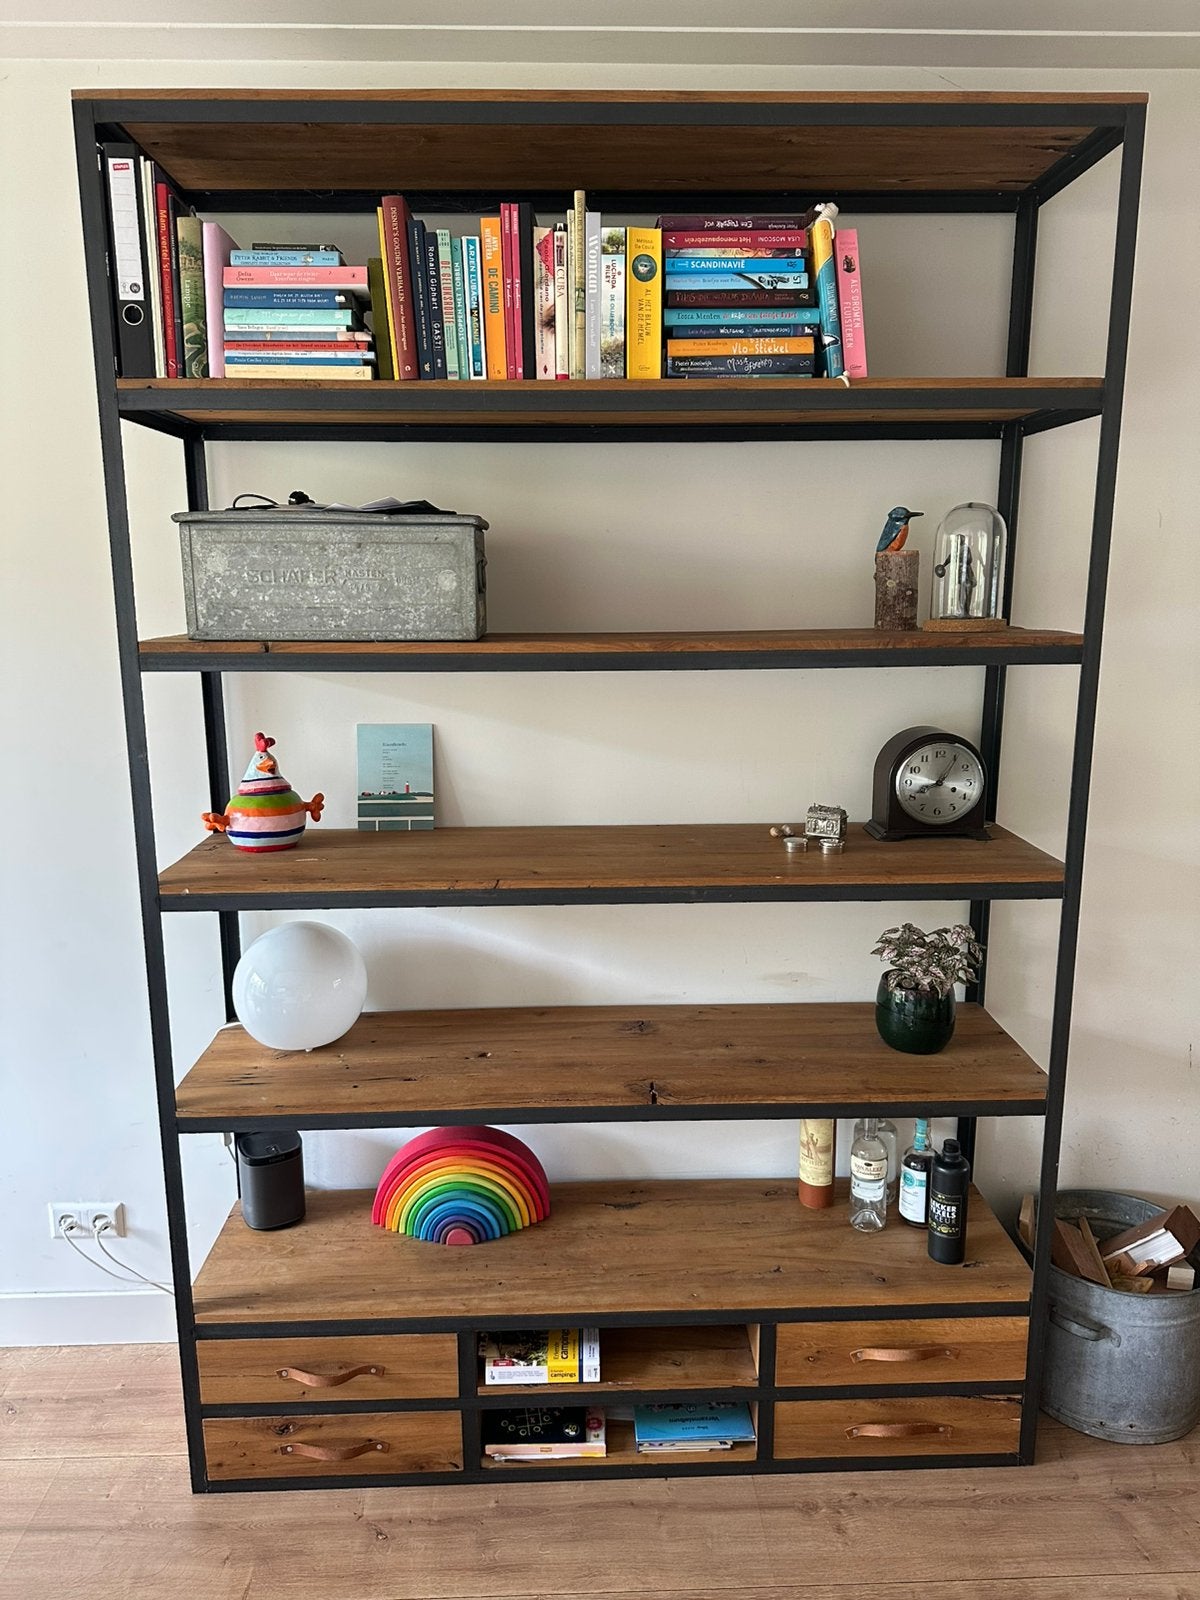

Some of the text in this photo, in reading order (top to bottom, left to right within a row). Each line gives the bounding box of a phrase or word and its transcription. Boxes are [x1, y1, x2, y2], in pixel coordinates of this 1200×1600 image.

[159, 209, 168, 233] Mam,
[390, 206, 400, 237] DISNEY'S
[161, 237, 169, 260] vertel
[393, 237, 402, 266] GOUDEN
[542, 238, 550, 264] Paolo
[684, 236, 738, 244] menopauzebrein
[441, 260, 451, 270] DE
[588, 234, 599, 294] Woman
[691, 259, 745, 269] SCANDINAVIË
[396, 266, 405, 302] VERHALEN
[428, 246, 439, 310] Ronald Giphart
[556, 268, 565, 298] CUBA
[442, 272, 455, 325] GELUKSROUTE
[468, 244, 481, 345] ARJEN LUBACH MAGNUS
[488, 267, 500, 314] DE CAMINO
[644, 288, 651, 297] AL
[850, 279, 861, 328] ALS DROMEN
[637, 313, 644, 322] DE
[695, 312, 721, 320] Menten
[843, 301, 853, 348] FLUISTEREN
[731, 342, 789, 354] Vlo Stiekel
[935, 750, 946, 758] 12
[909, 766, 921, 774] 10
[930, 1198, 957, 1212] LEKKER
[930, 1205, 957, 1219] TEXELS
